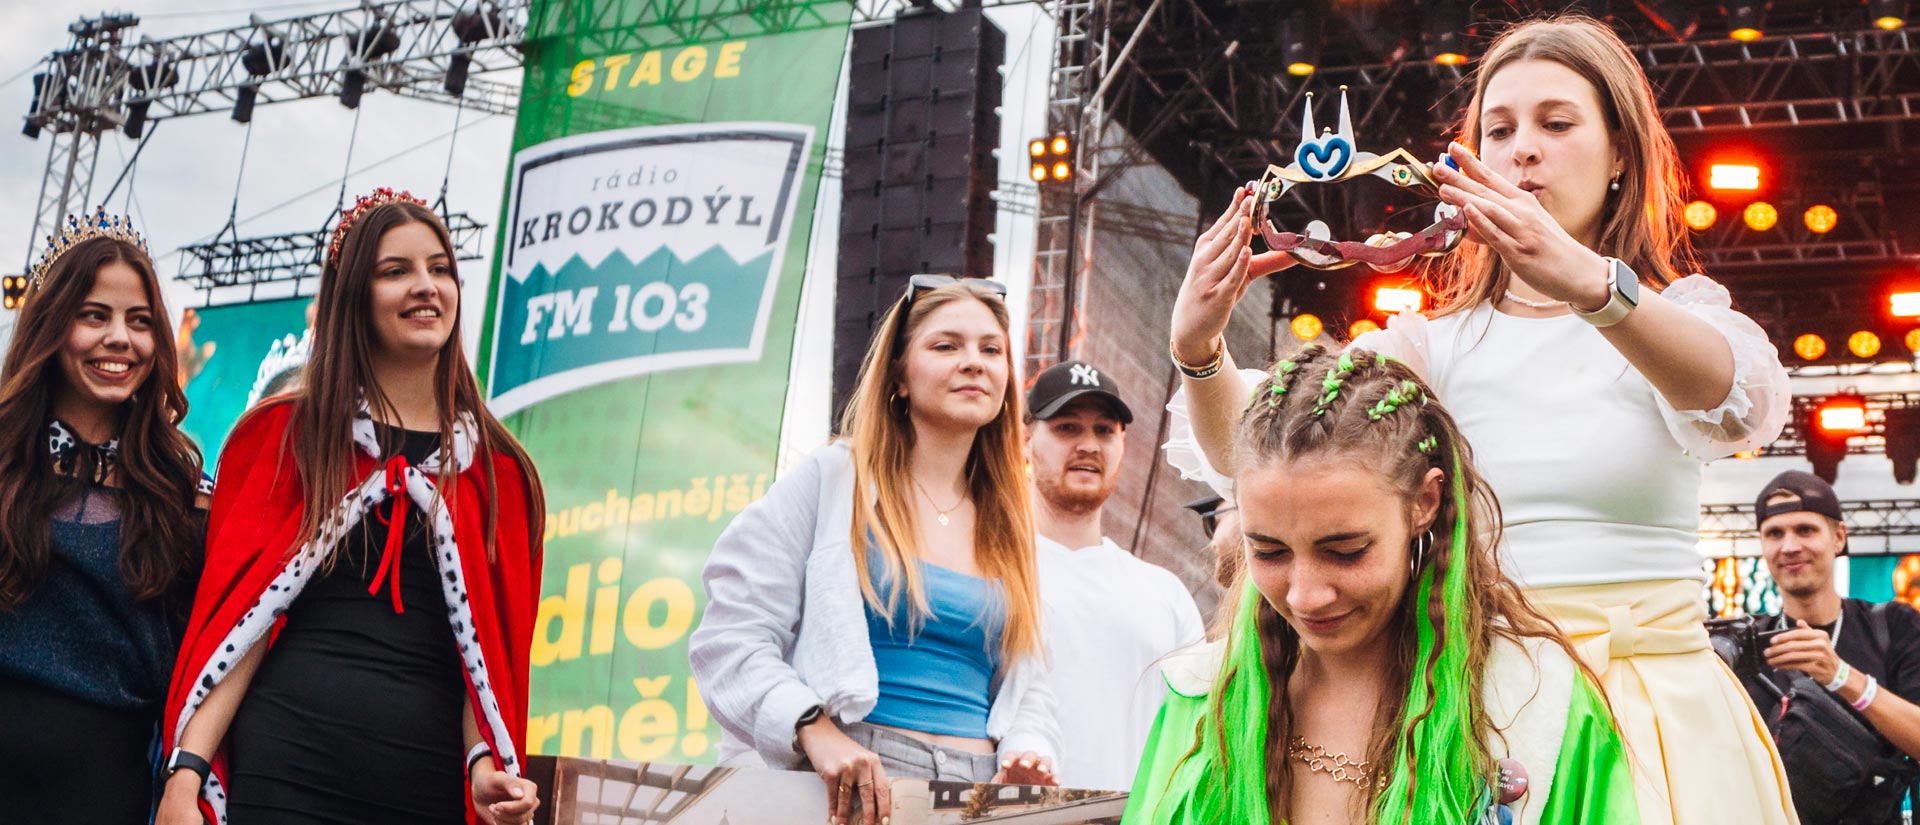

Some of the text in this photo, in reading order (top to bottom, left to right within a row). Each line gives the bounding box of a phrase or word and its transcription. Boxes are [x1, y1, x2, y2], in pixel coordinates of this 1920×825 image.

[567, 41, 747, 98] STAGE
[592, 166, 678, 192] rádio
[518, 185, 763, 250] KROKODÝL
[520, 281, 711, 345] FM 103
[530, 557, 695, 667] dio
